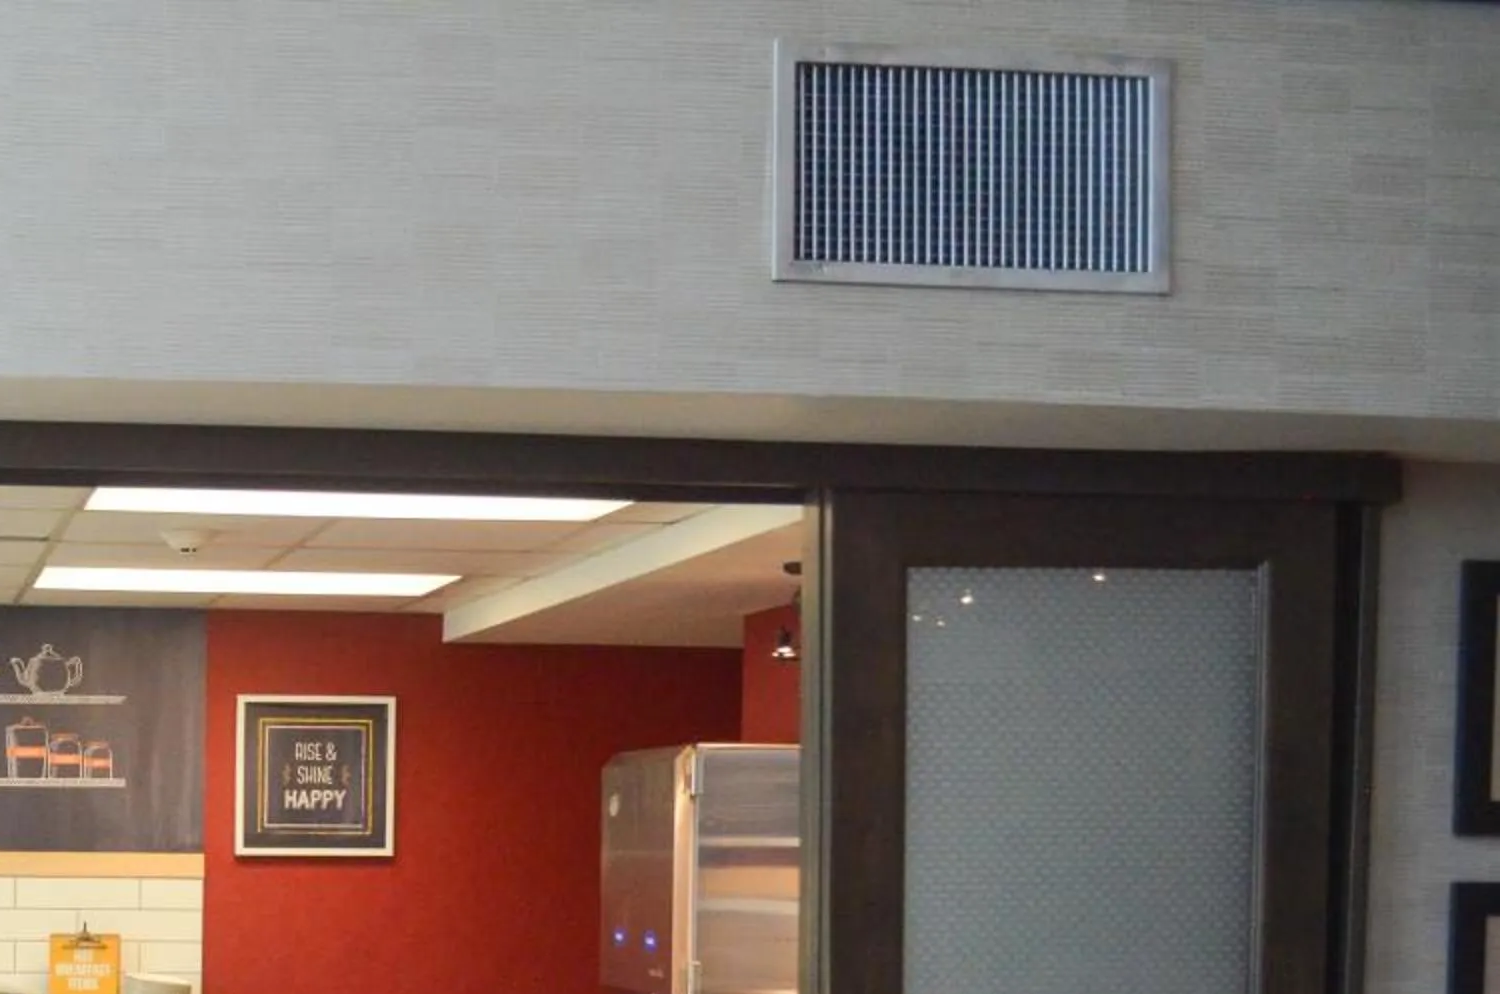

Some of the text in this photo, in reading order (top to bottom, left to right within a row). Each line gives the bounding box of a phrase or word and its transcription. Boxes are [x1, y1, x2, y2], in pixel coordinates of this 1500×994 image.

[295, 742, 337, 761] RISE &
[297, 765, 333, 785] SHINE
[284, 789, 347, 810] HAPPY
